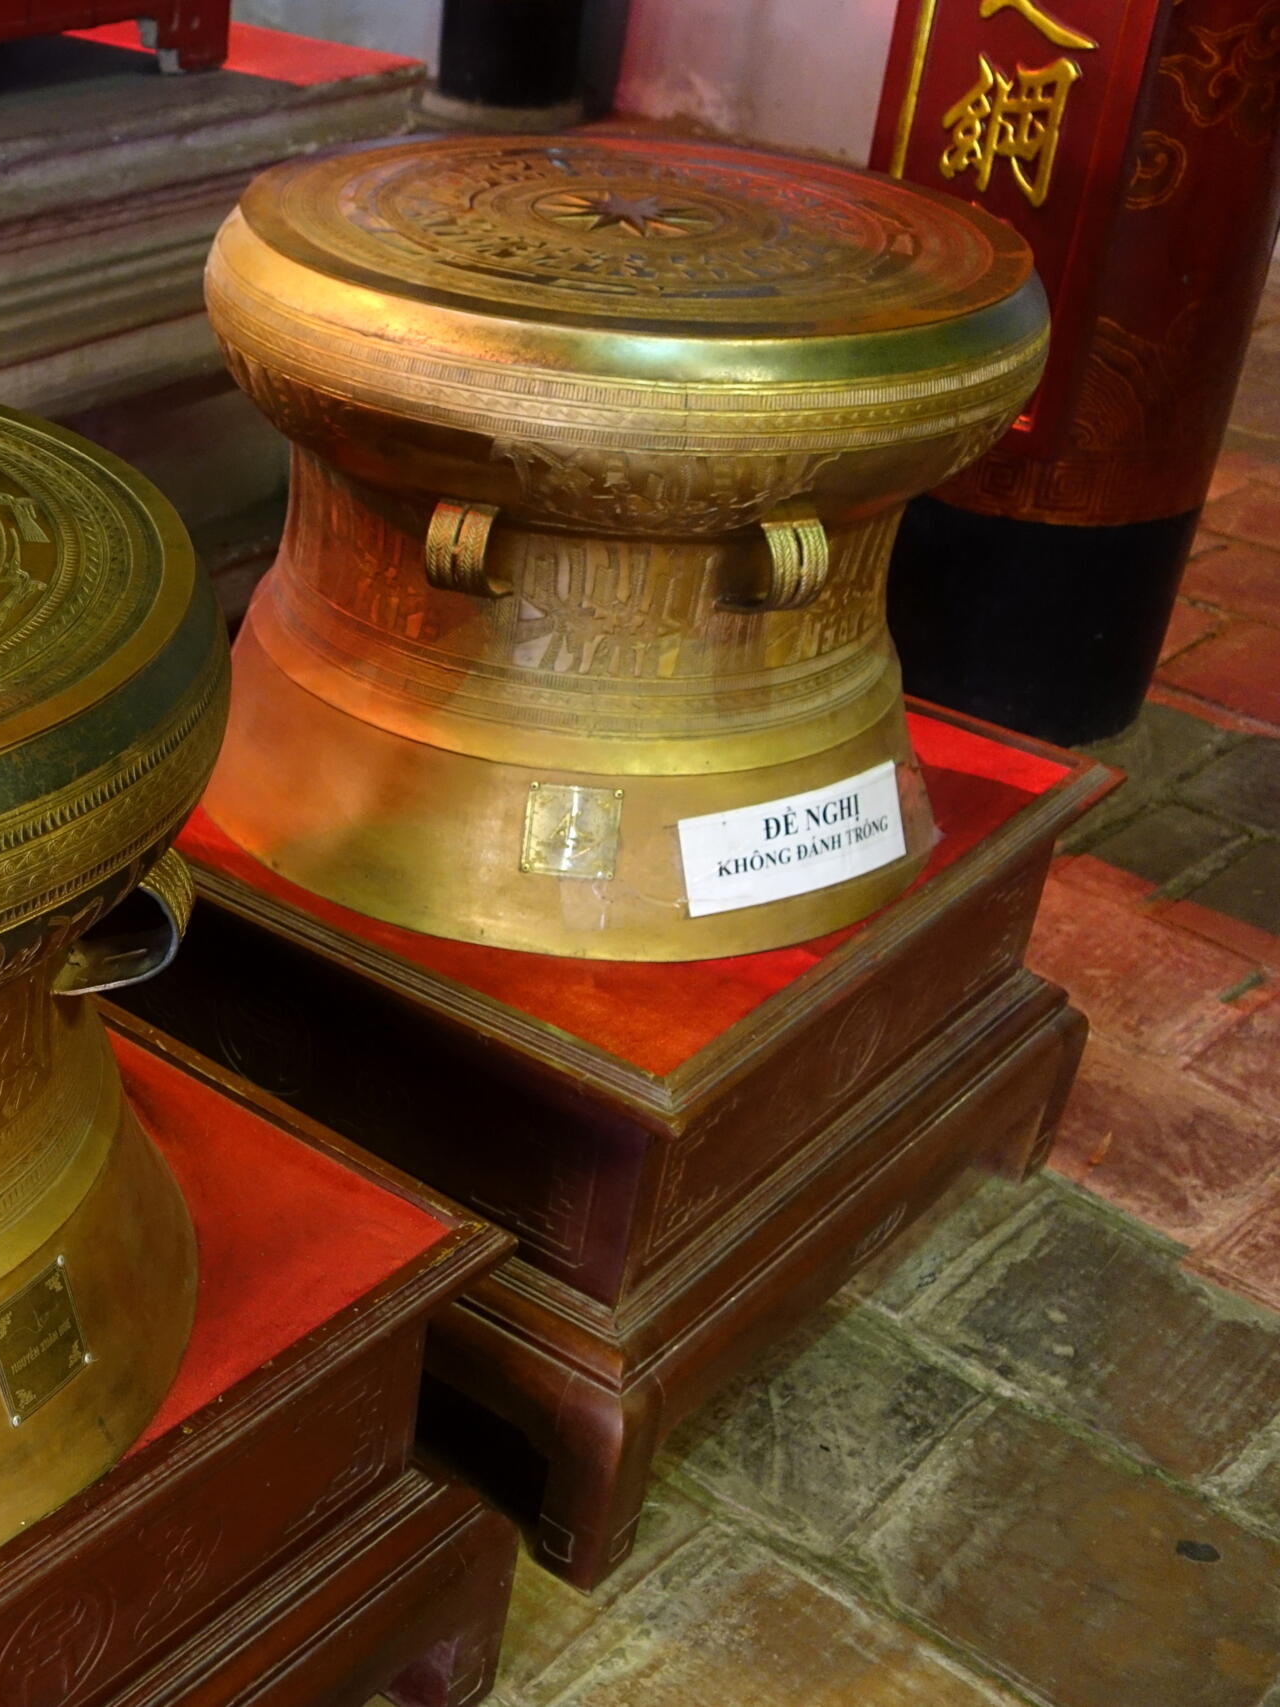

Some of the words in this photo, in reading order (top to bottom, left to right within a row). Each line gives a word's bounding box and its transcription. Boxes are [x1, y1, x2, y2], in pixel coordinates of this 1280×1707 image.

[805, 793, 859, 831] NGHỊ
[717, 848, 791, 877] KHÔNG
[796, 835, 841, 860] ĐÁNH
